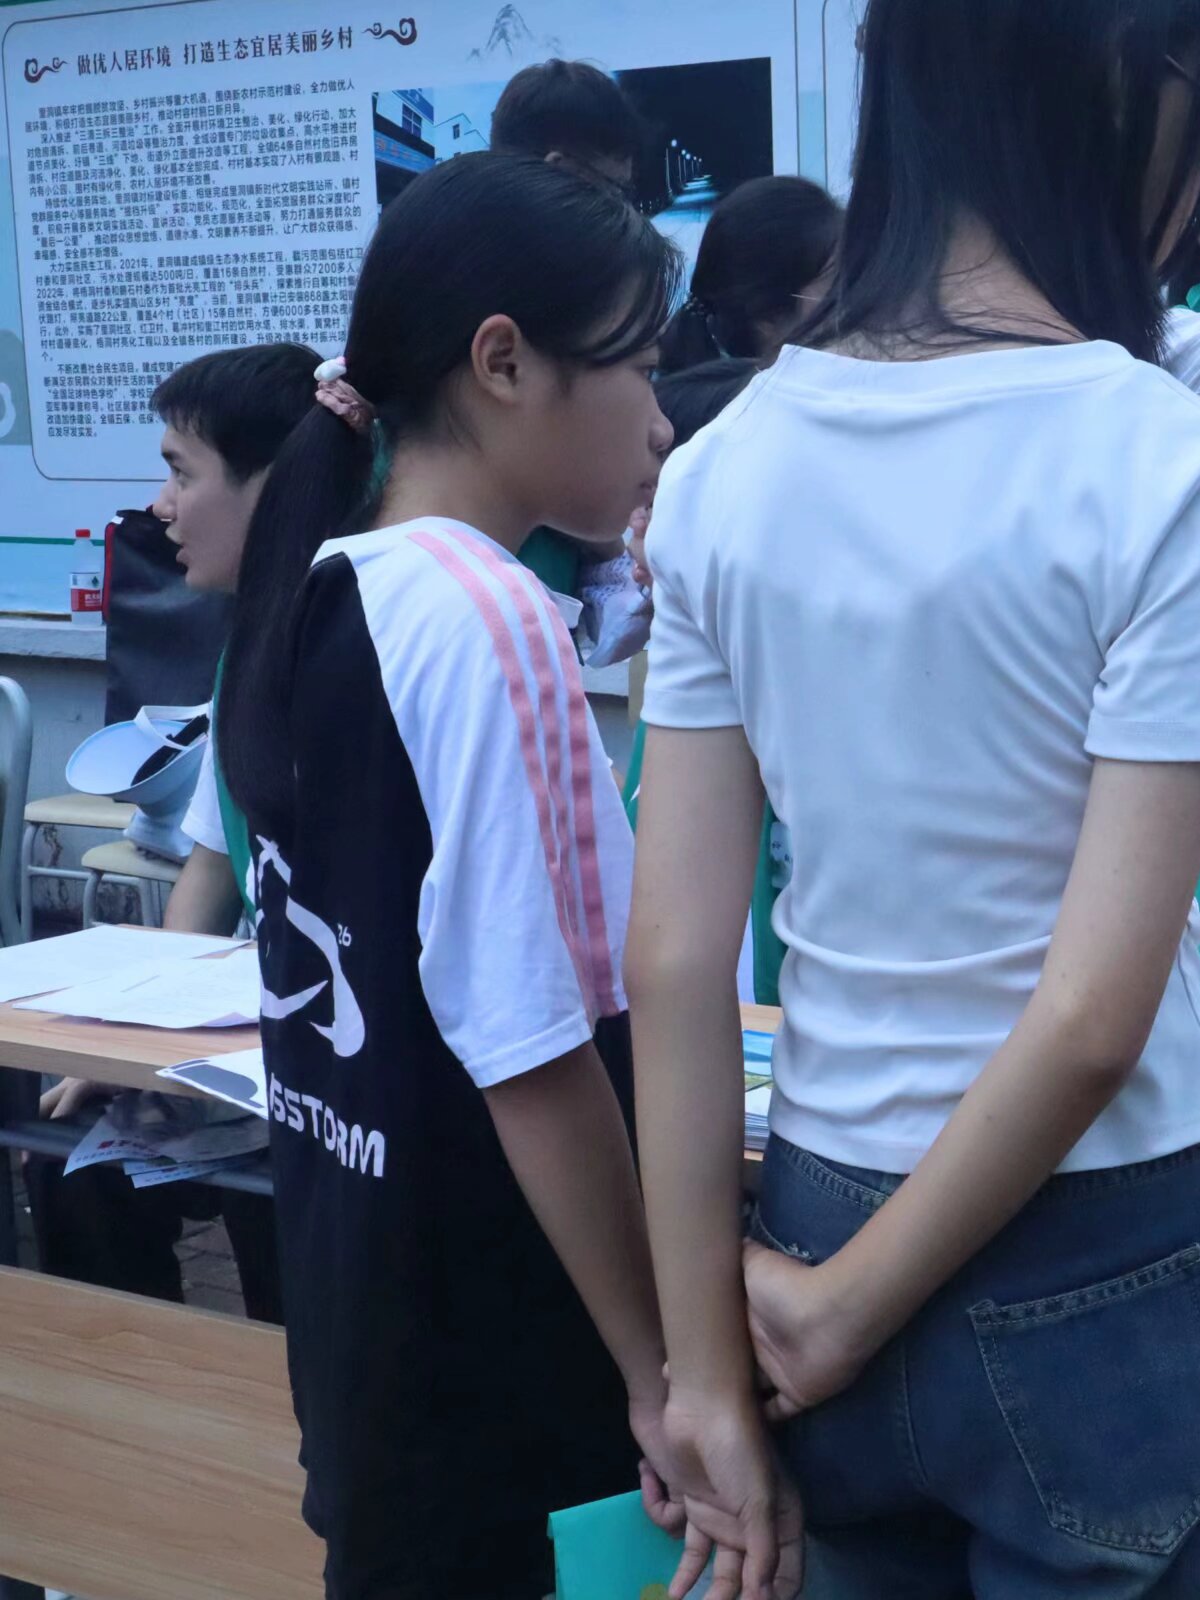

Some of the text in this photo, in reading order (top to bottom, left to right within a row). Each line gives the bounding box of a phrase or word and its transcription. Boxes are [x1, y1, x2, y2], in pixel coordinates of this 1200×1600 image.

[77, 25, 354, 77] 做优人居环境 打造生态宜居美丽乡村
[270, 1072, 385, 1178] SSTORM
